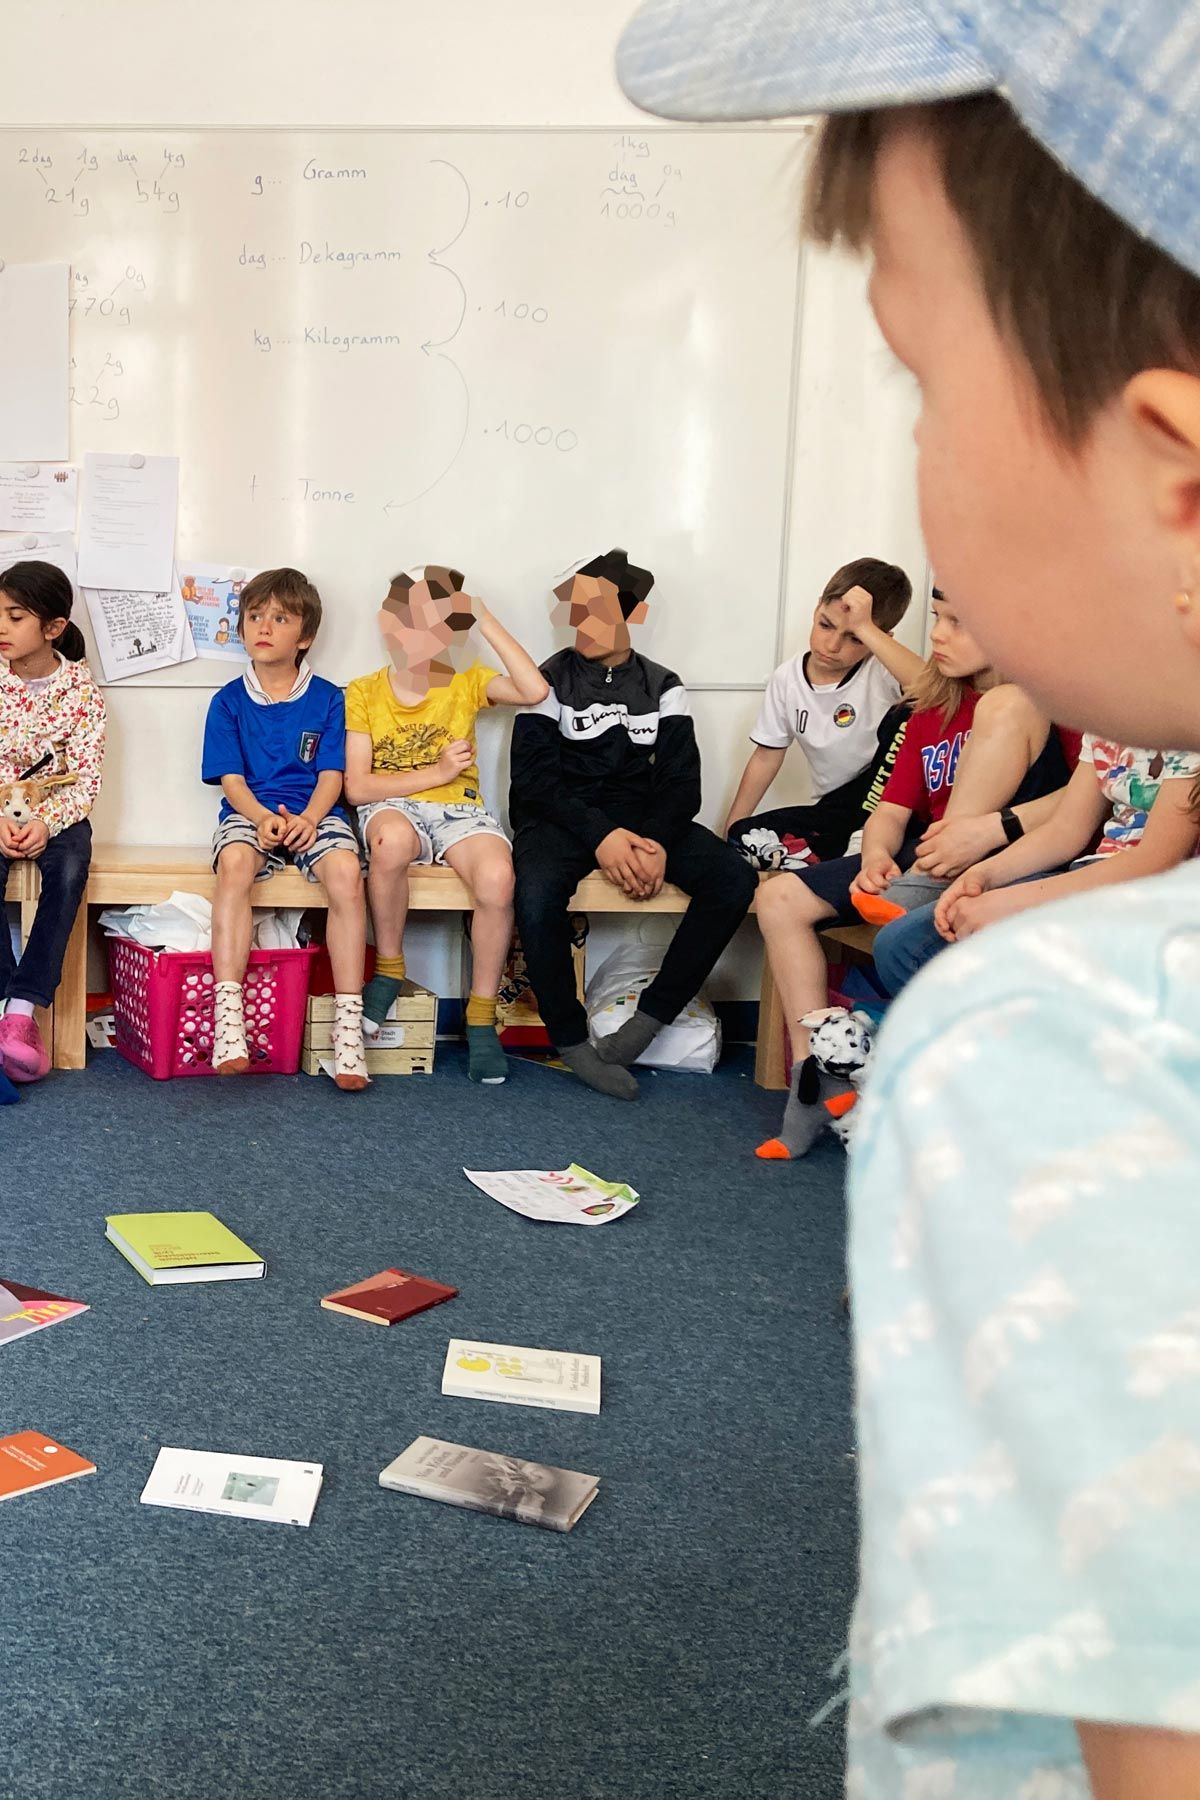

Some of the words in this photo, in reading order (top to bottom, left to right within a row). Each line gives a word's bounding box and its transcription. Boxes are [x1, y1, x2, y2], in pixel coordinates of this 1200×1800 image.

[303, 158, 367, 180] Gramm
[608, 162, 638, 187] dag
[238, 245, 267, 269] dag
[299, 241, 401, 269] Dekagramm
[253, 329, 273, 352] kg
[304, 326, 401, 353] Kilogramm
[299, 477, 356, 504] Tonne
[796, 708, 809, 734] 10
